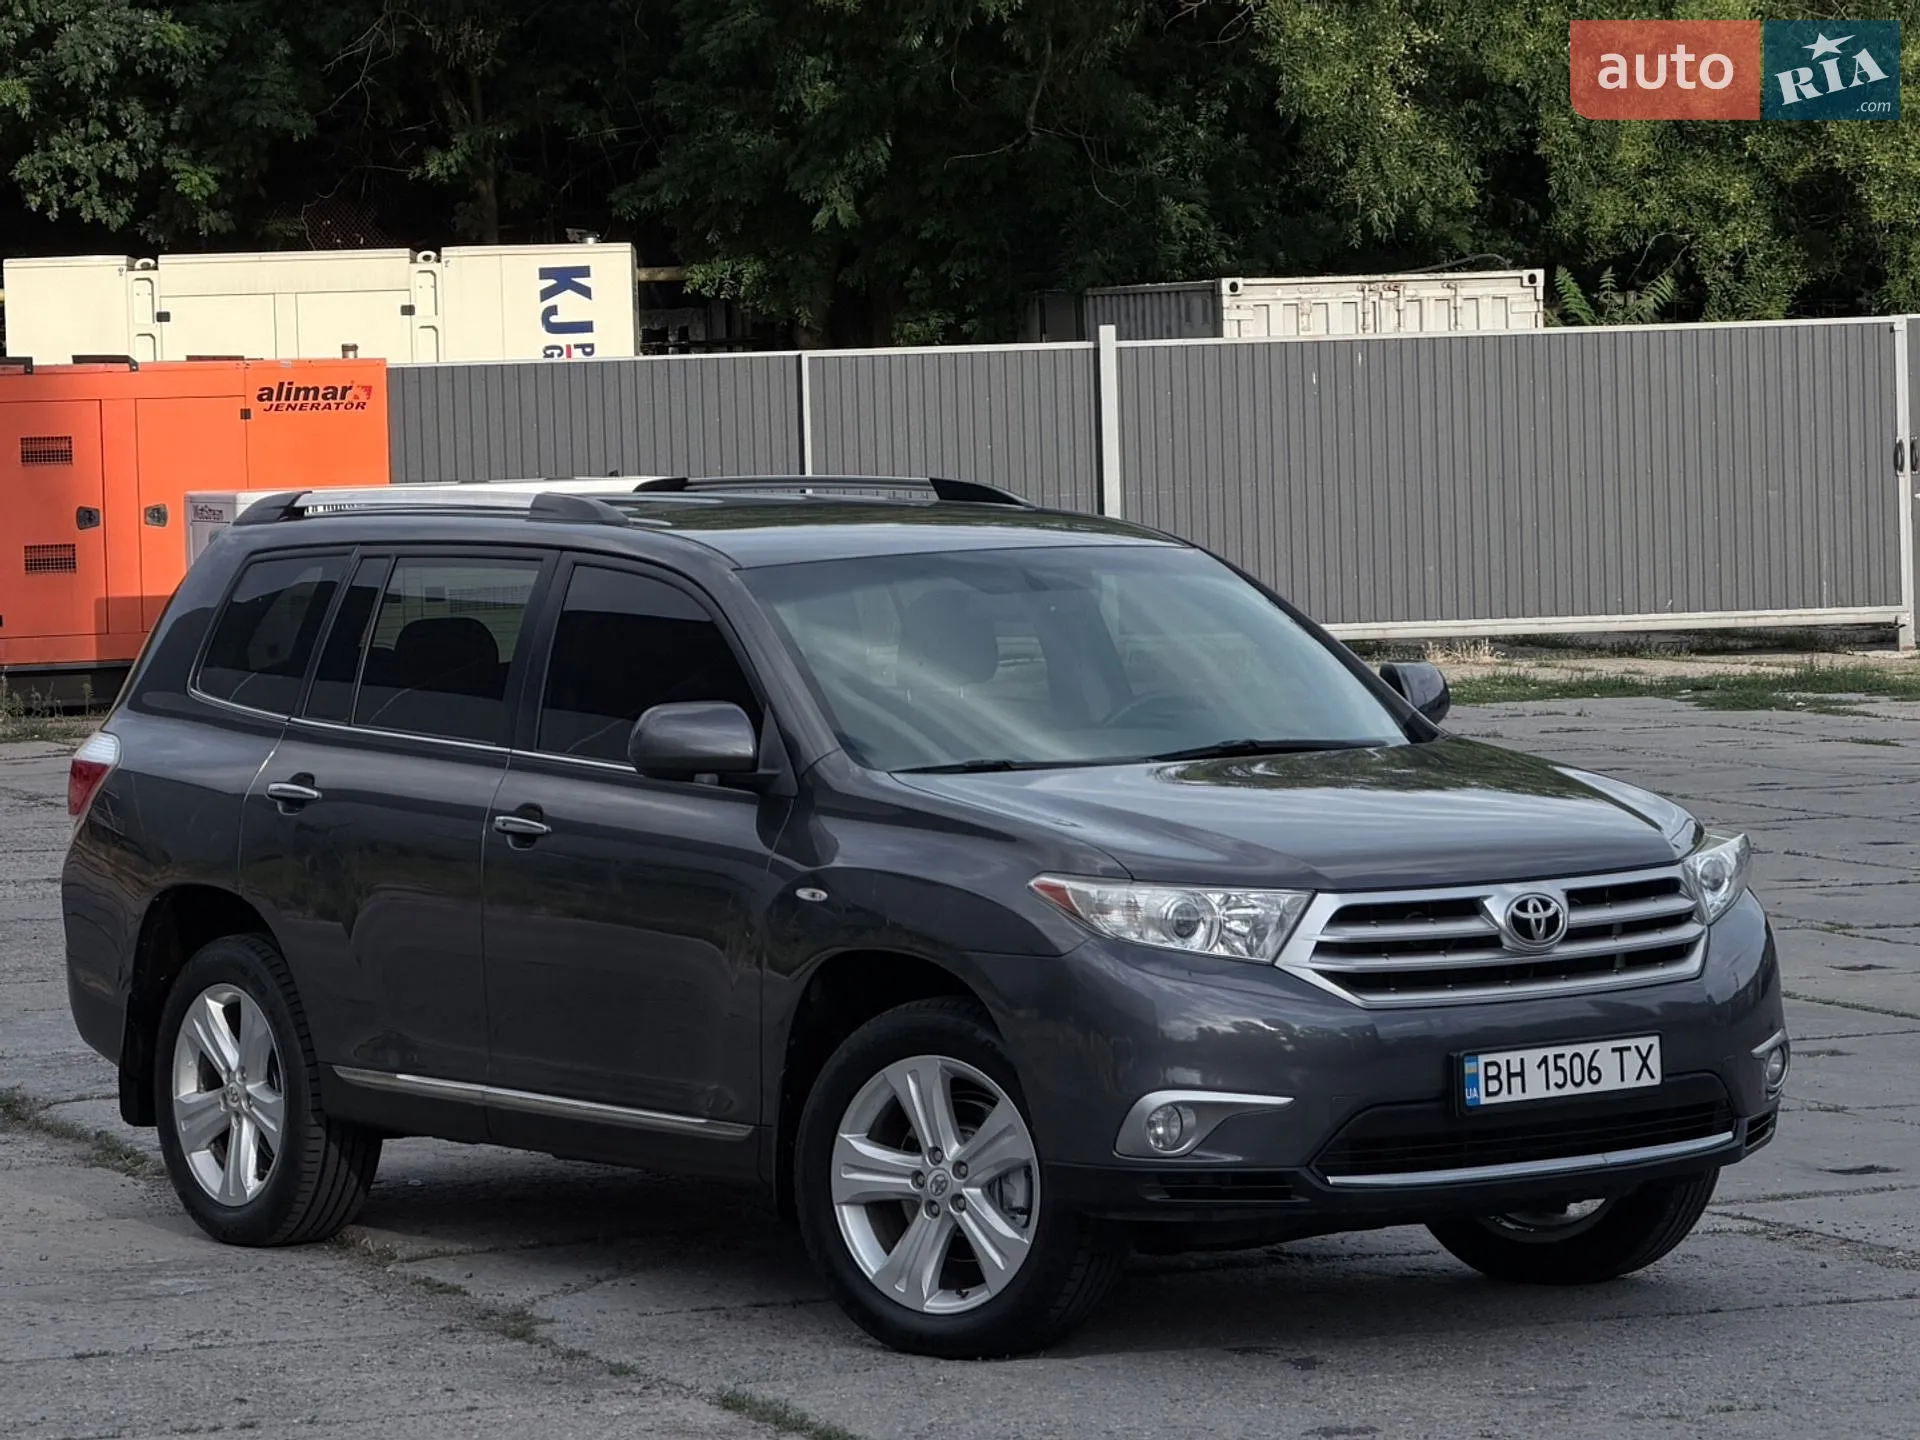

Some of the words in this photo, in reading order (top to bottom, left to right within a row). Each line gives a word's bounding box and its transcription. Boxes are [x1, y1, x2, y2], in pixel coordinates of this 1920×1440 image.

[538, 265, 595, 335] KJ
[256, 381, 353, 402] alimar
[1483, 1058, 1527, 1098] BH
[1536, 1049, 1603, 1091] 1506
[1611, 1043, 1656, 1083] TX
[1465, 1087, 1480, 1100] UA
